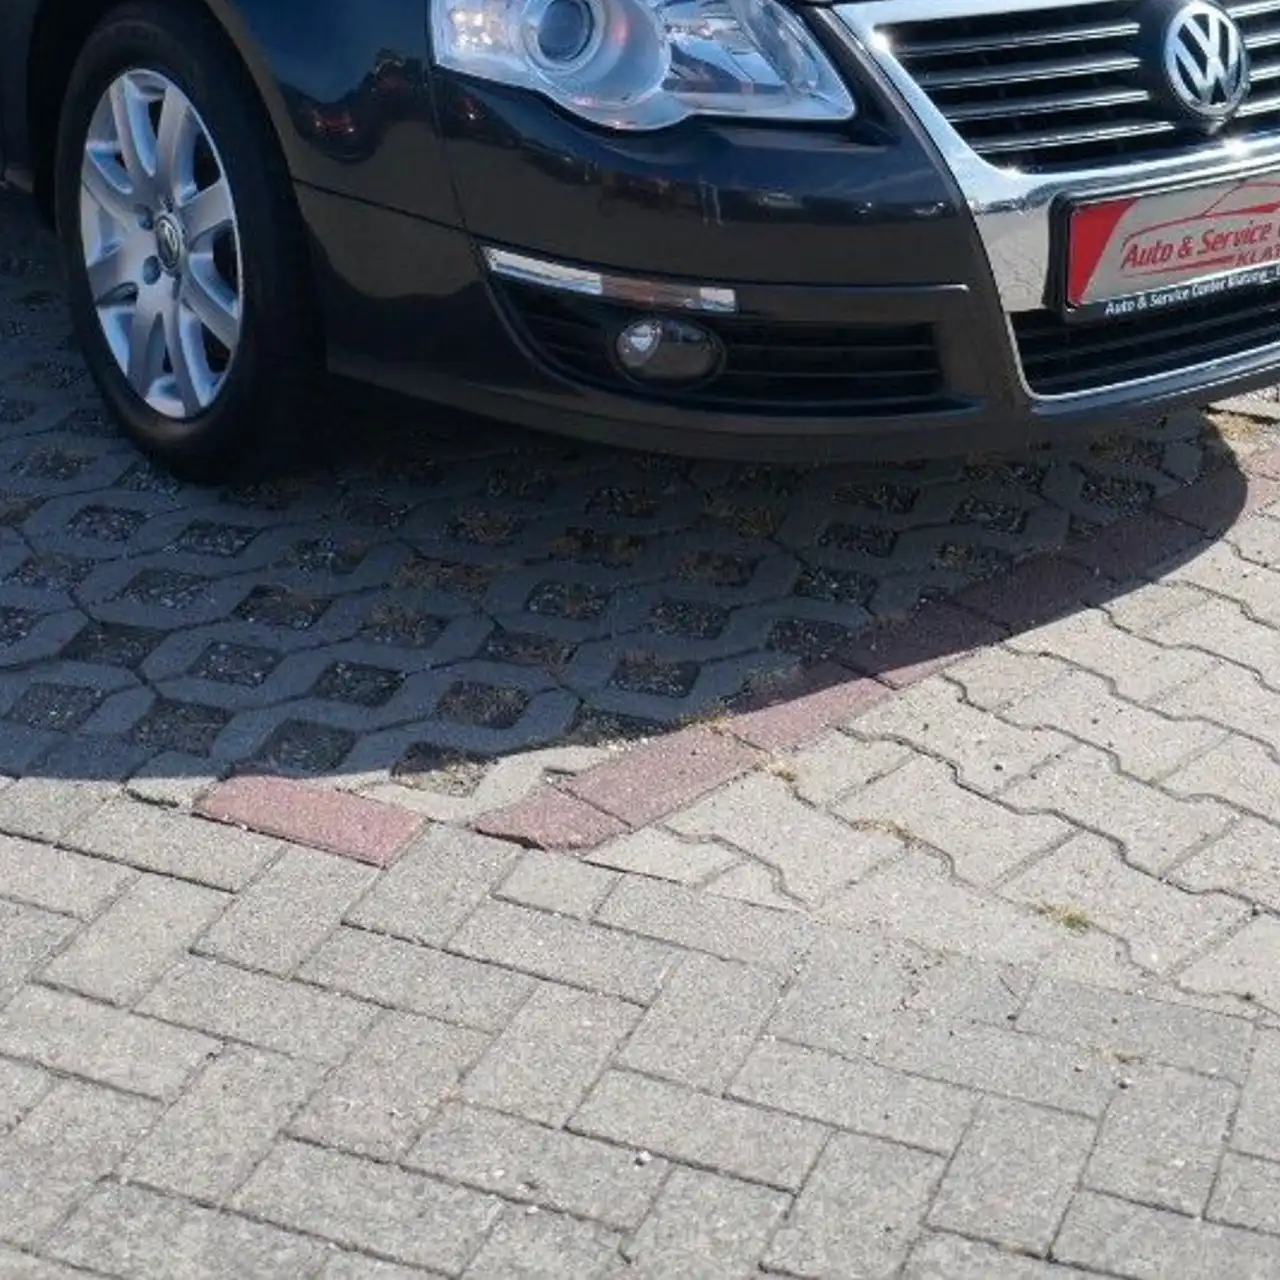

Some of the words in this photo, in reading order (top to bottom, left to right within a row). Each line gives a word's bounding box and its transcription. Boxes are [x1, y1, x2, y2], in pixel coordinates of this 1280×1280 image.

[1166, 1, 1245, 116] VW
[1120, 240, 1174, 269] Auto
[1177, 235, 1194, 259] &
[1197, 220, 1273, 255] Service
[1104, 299, 1136, 316] Auto
[1136, 295, 1148, 311] &
[1148, 289, 1190, 307] Service
[1191, 279, 1227, 299] Center
